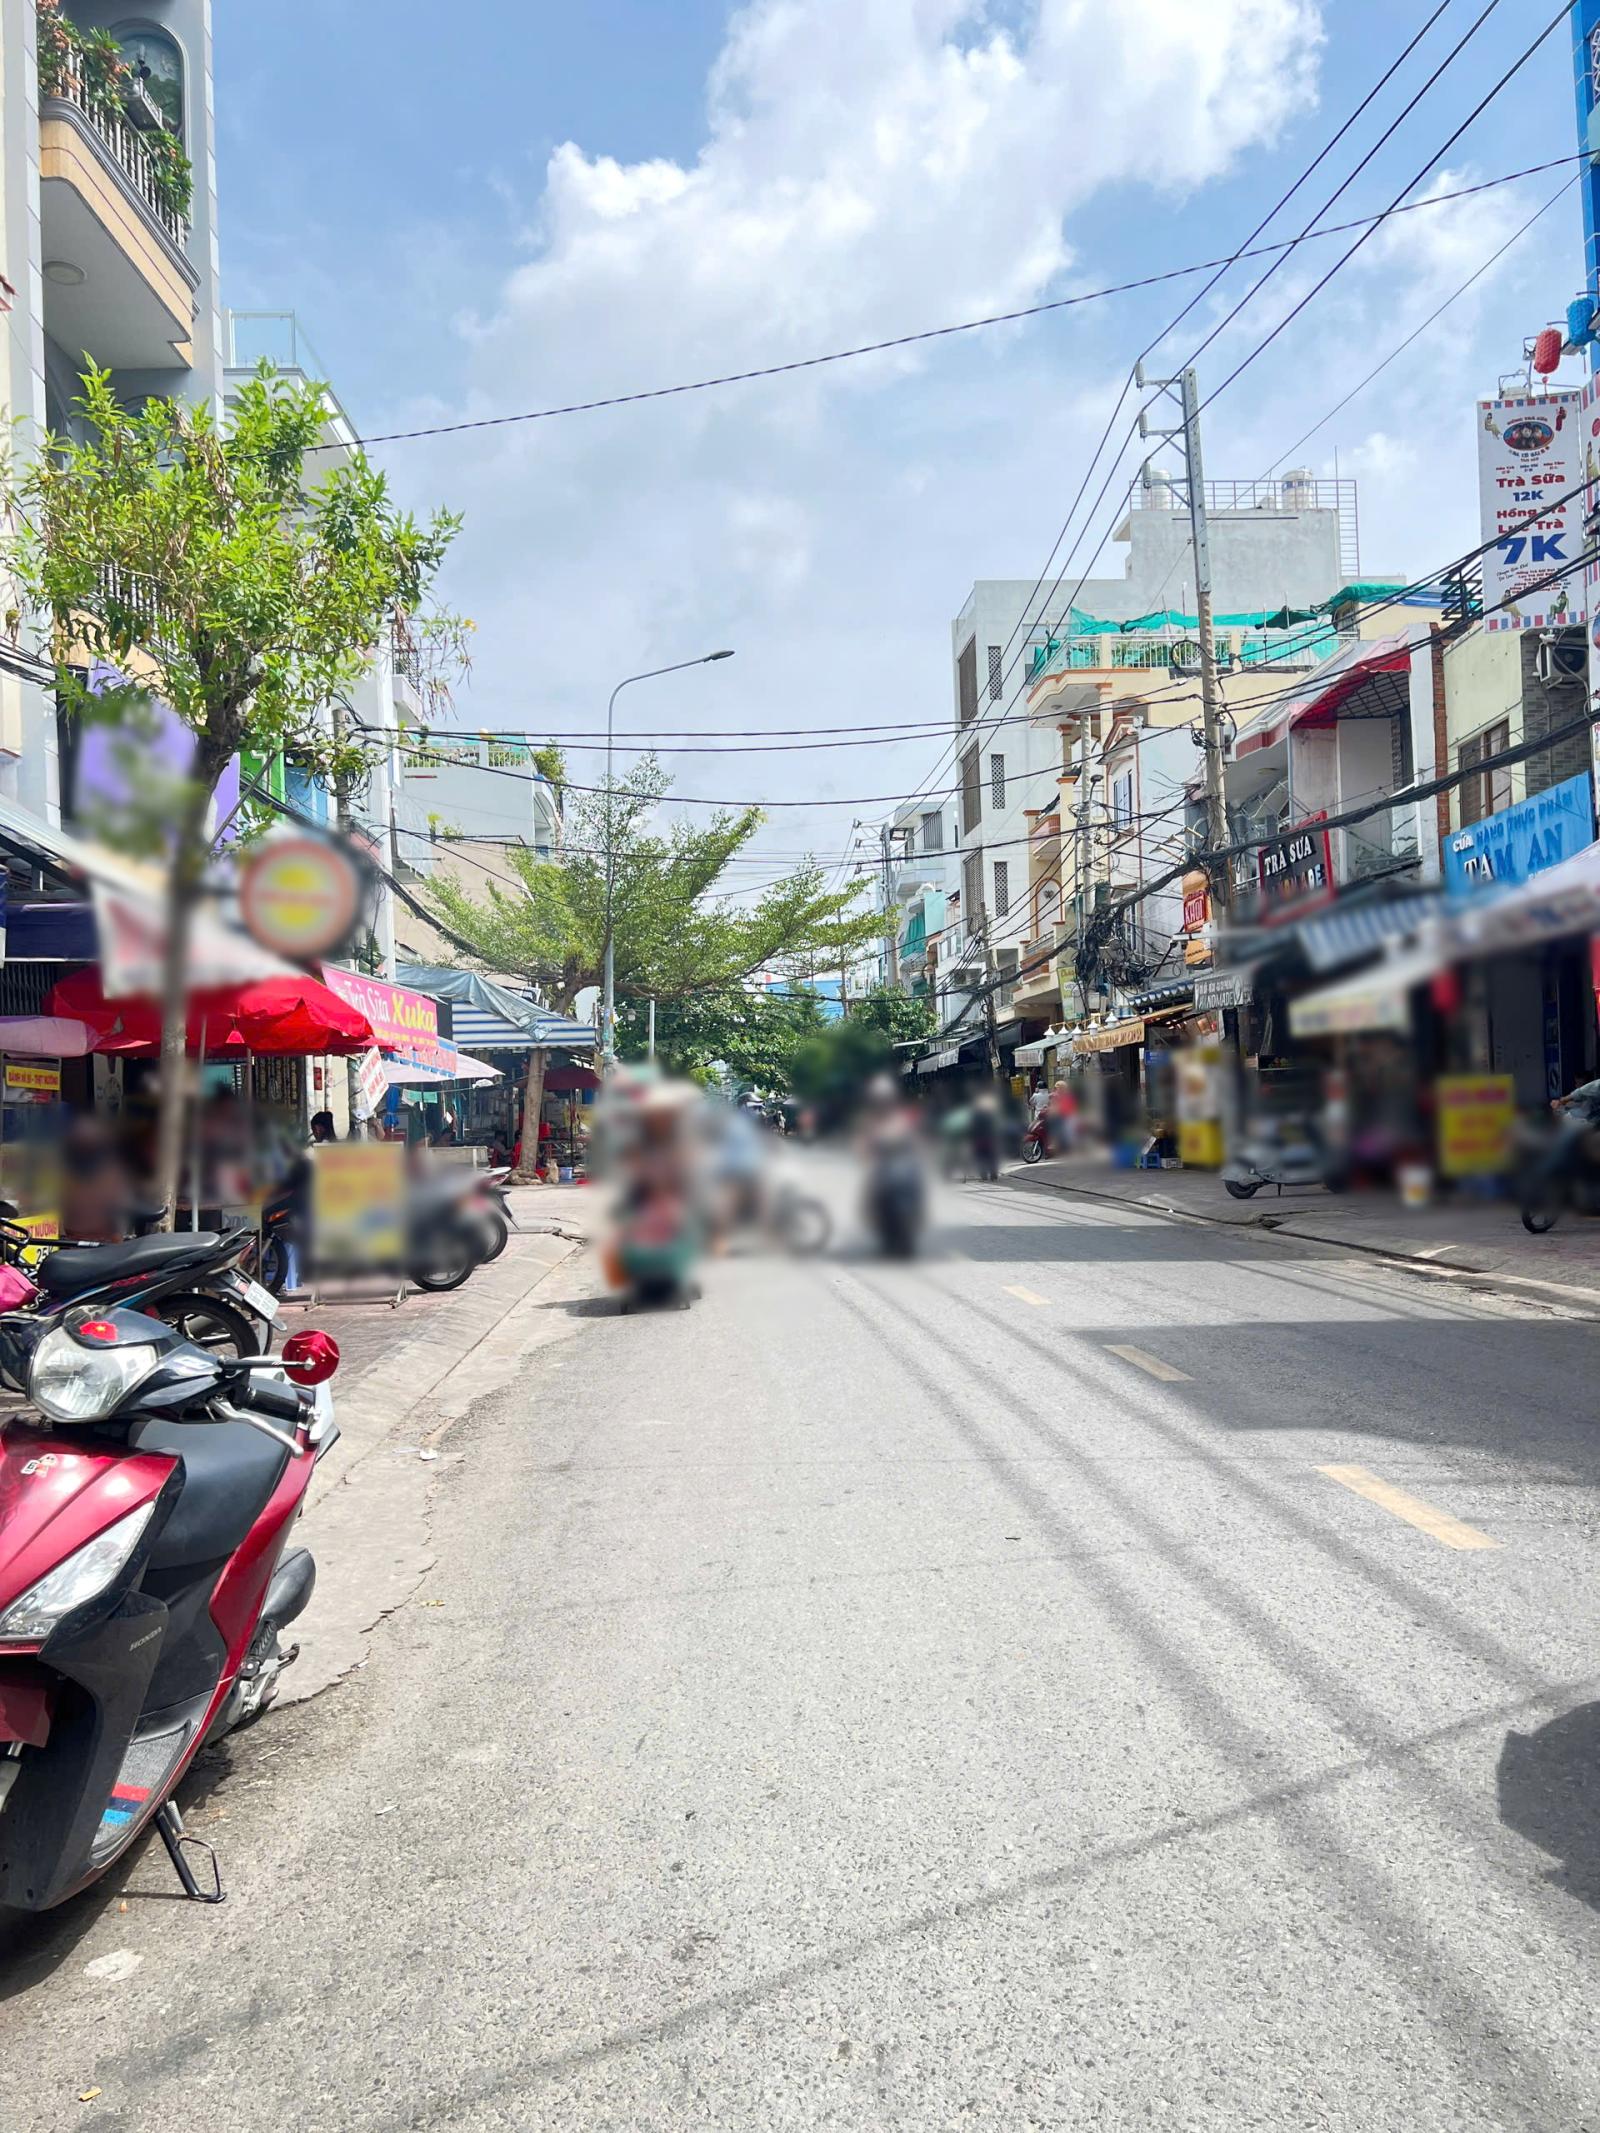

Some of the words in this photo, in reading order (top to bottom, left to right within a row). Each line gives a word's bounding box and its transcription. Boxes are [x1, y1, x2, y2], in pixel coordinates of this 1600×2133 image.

[1496, 476, 1525, 488] Trà
[1531, 473, 1565, 485] Sữa
[1513, 490, 1544, 502] 12K
[1534, 519, 1564, 530] Trà
[1497, 533, 1568, 565] 7K
[1264, 844, 1287, 876] TRÀ
[1528, 823, 1563, 871] AN
[391, 991, 436, 1033] Xuka
